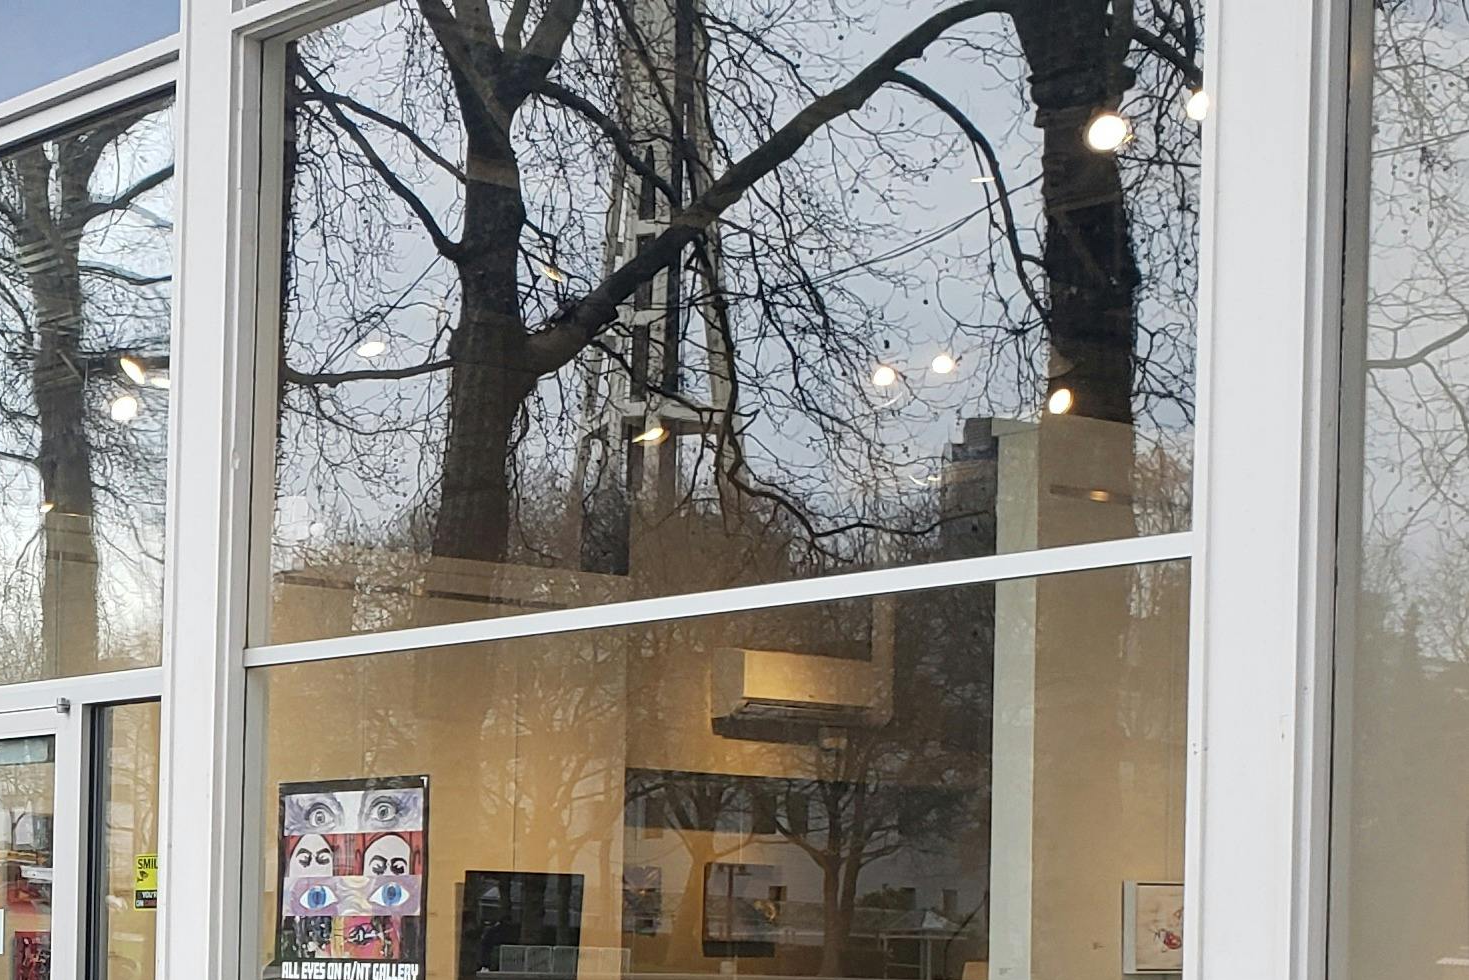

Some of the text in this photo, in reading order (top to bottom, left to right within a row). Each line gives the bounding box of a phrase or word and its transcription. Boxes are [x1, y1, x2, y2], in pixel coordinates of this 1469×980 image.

[137, 858, 158, 870] SMIL
[281, 961, 300, 979] ALL
[301, 962, 326, 980] EYES
[327, 962, 342, 980] ON
